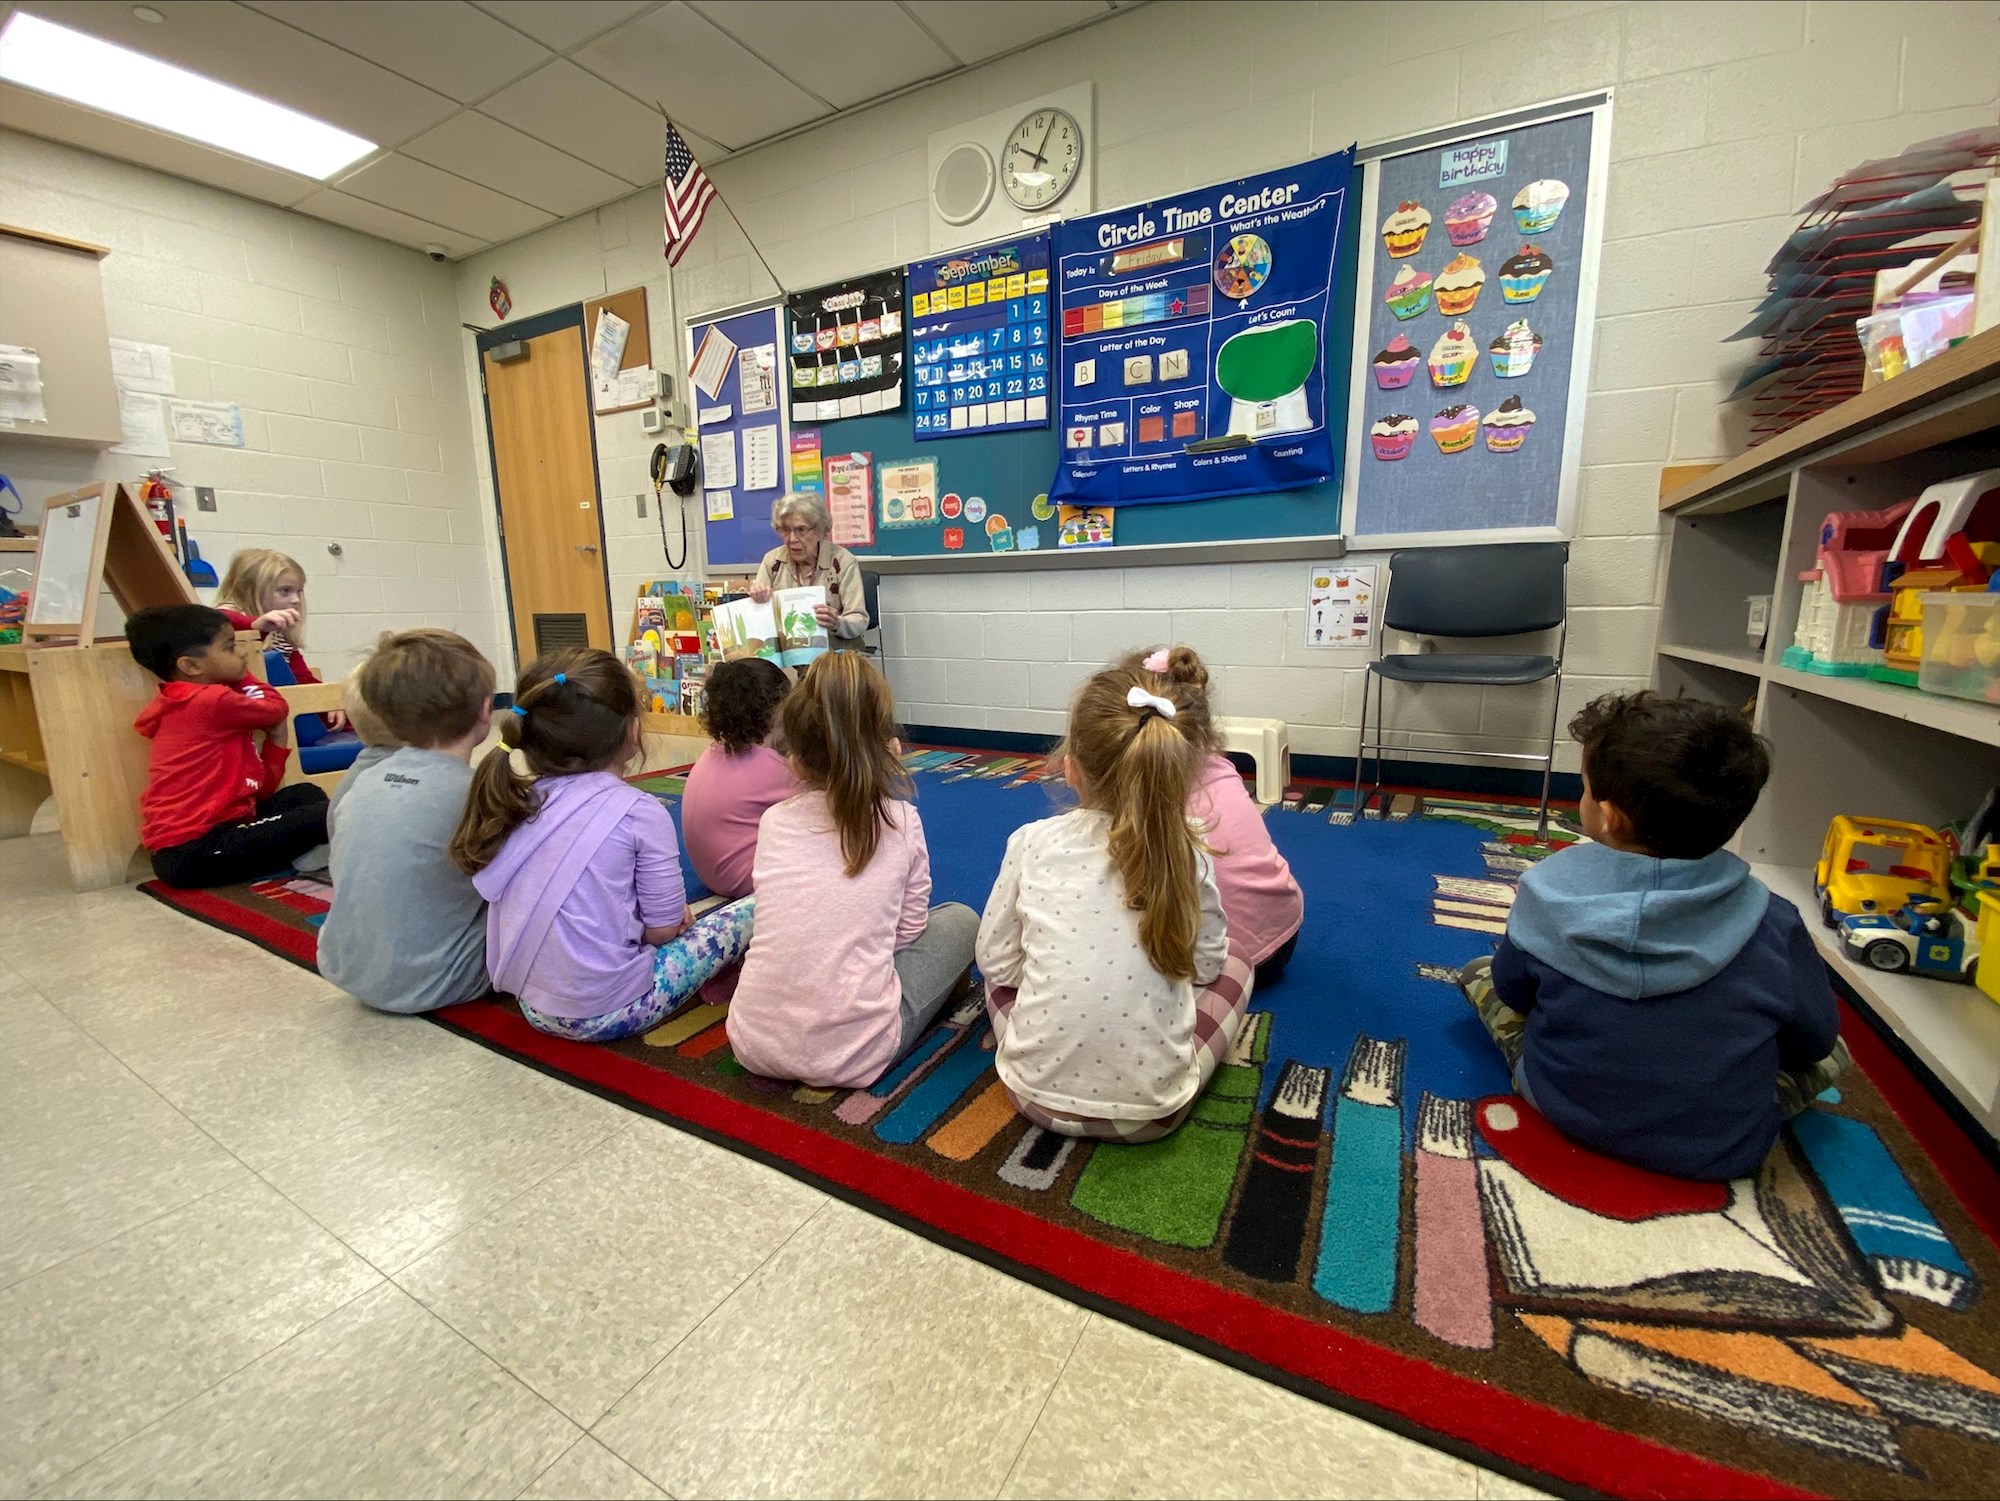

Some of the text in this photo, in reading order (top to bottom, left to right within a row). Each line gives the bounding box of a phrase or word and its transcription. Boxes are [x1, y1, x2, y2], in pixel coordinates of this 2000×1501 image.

[1035, 117, 1044, 129] 12
[1022, 127, 1029, 138] 11
[1062, 128, 1068, 139] 2
[1011, 143, 1020, 154] 10
[1066, 144, 1073, 155] 3
[1453, 144, 1496, 163] Happy
[1008, 162, 1014, 173] 9
[1062, 163, 1068, 174] 4
[1442, 160, 1505, 182] Birthday
[1013, 178, 1018, 188] 8
[1051, 179, 1057, 190] 5
[1036, 189, 1042, 199] 6
[1098, 183, 1300, 248] Circle Time Center
[1230, 199, 1326, 233] What's the Weather?
[1128, 252, 1163, 267] Friday
[941, 254, 1012, 281] September
[1066, 267, 1096, 279] Today is
[1099, 279, 1168, 299] Days of the Week
[1012, 300, 1041, 318] 1 2
[1404, 302, 1422, 314] April
[1248, 307, 1296, 324] Let's Count
[919, 346, 926, 359] 3
[936, 343, 943, 356] 4
[973, 336, 980, 349] 6
[992, 333, 1000, 346] 7
[1013, 329, 1021, 343] 8
[1033, 326, 1042, 340] 9
[1100, 336, 1166, 353] Letter of the Day
[917, 353, 1044, 384] 10 11 12 13 14 15 16
[1080, 354, 1180, 382] B C N
[917, 377, 1045, 405] 17 18 19 20 21 22 23
[1140, 405, 1161, 415] Color
[1174, 400, 1200, 410] Shape
[917, 414, 947, 428] 24 25
[1075, 410, 1118, 423] Rhyme Time
[1273, 447, 1304, 458] Counting
[1192, 453, 1247, 467] Colors & Shapes
[1072, 470, 1097, 479] Calendar
[1123, 464, 1144, 474] Letters
[1151, 462, 1177, 471] Rhymes
[384, 773, 420, 786] Wilson
